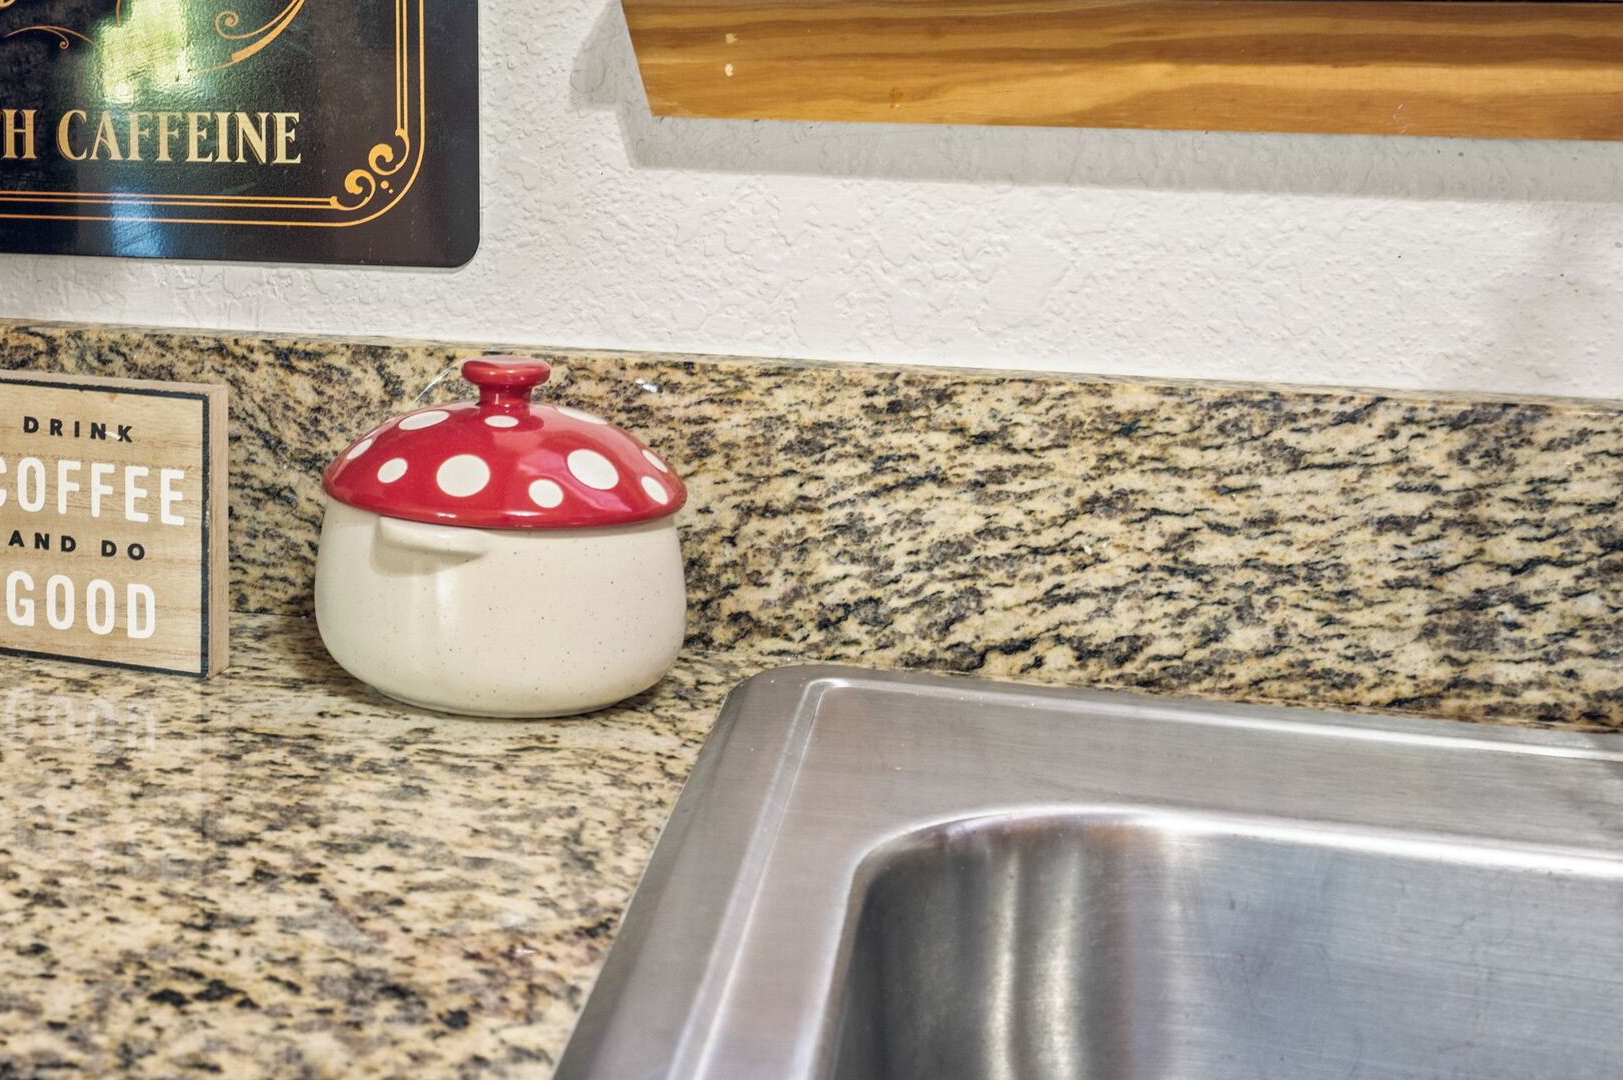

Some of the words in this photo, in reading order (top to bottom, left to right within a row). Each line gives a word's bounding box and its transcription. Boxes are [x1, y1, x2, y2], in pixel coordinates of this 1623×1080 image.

[55, 109, 302, 166] CAFFEINE
[23, 415, 134, 443] DRINK
[8, 530, 77, 552] AND
[101, 539, 146, 560] DO
[5, 570, 156, 639] GOOD
